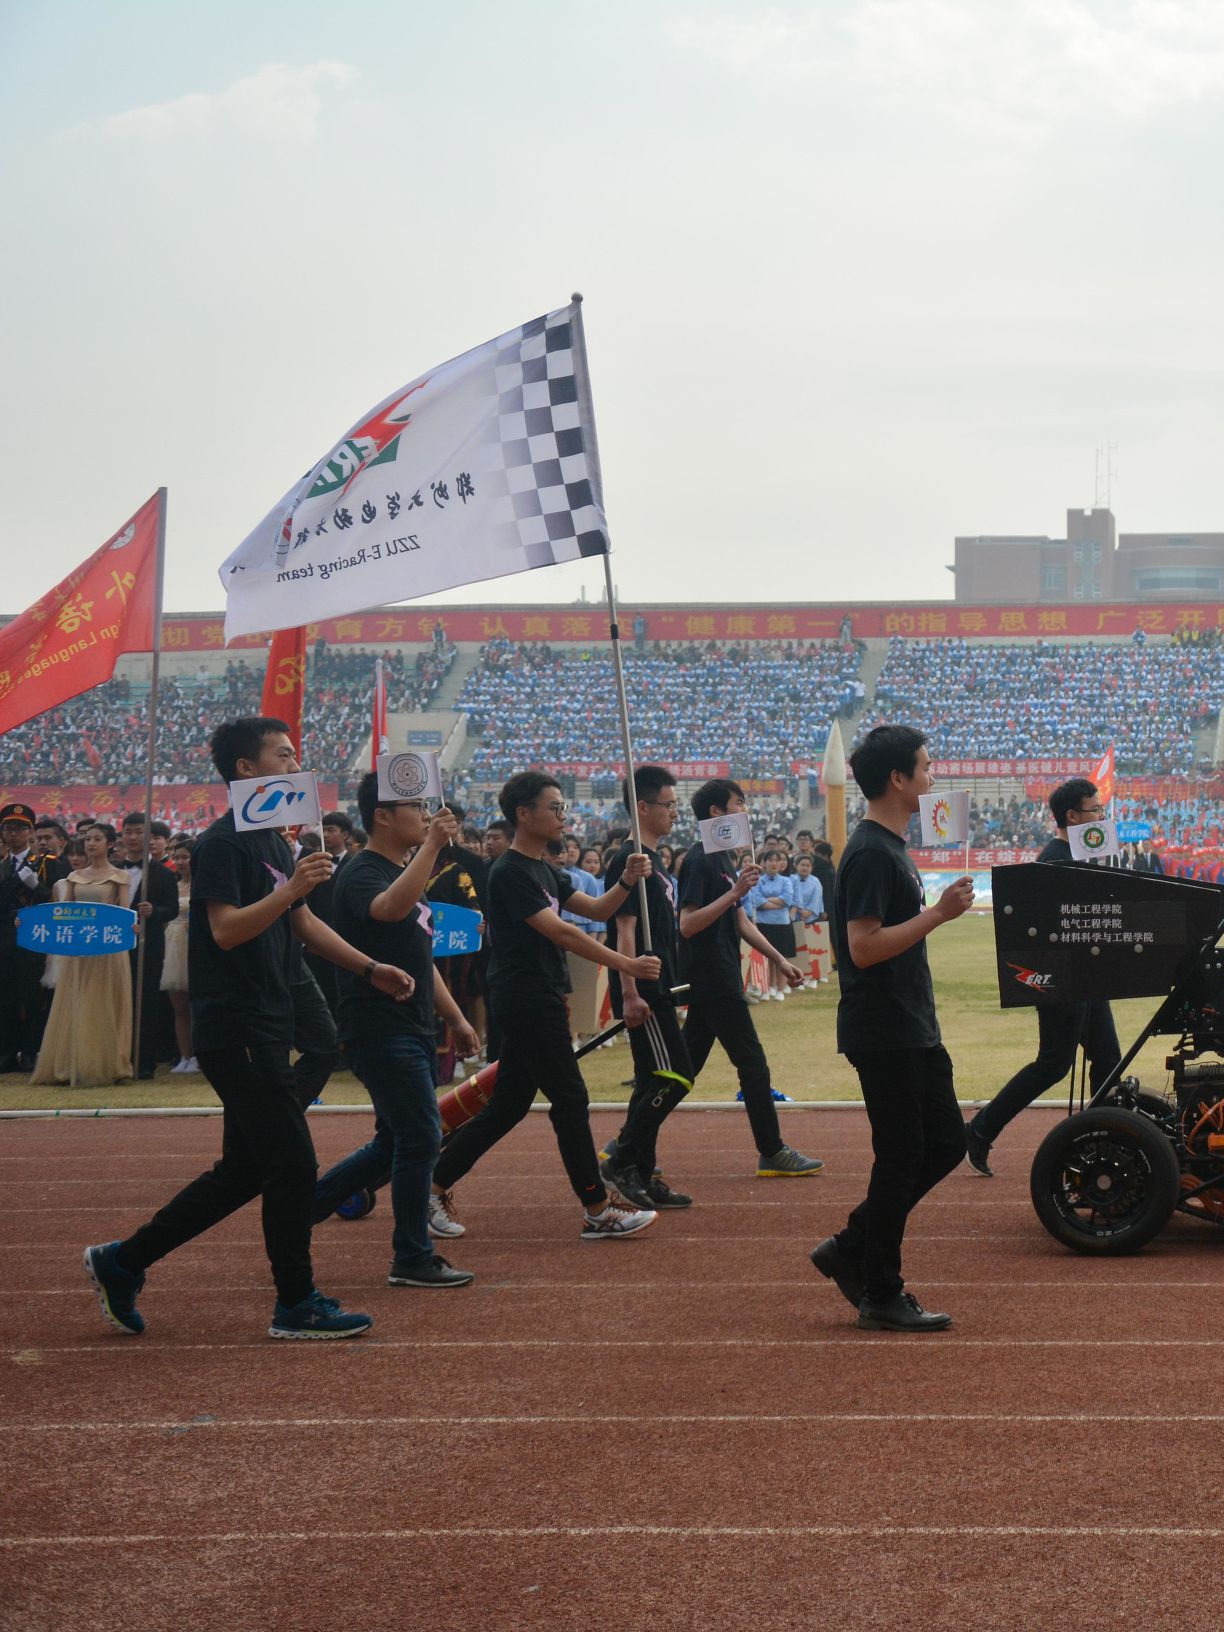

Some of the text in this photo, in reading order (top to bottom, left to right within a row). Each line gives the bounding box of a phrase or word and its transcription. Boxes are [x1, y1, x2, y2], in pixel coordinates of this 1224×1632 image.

[1060, 903, 1122, 915] 机械工程学院
[1060, 918, 1122, 929] 电气工程学院
[31, 923, 123, 945] 外语学院
[1060, 931, 1154, 943] 材料科学与工程学院
